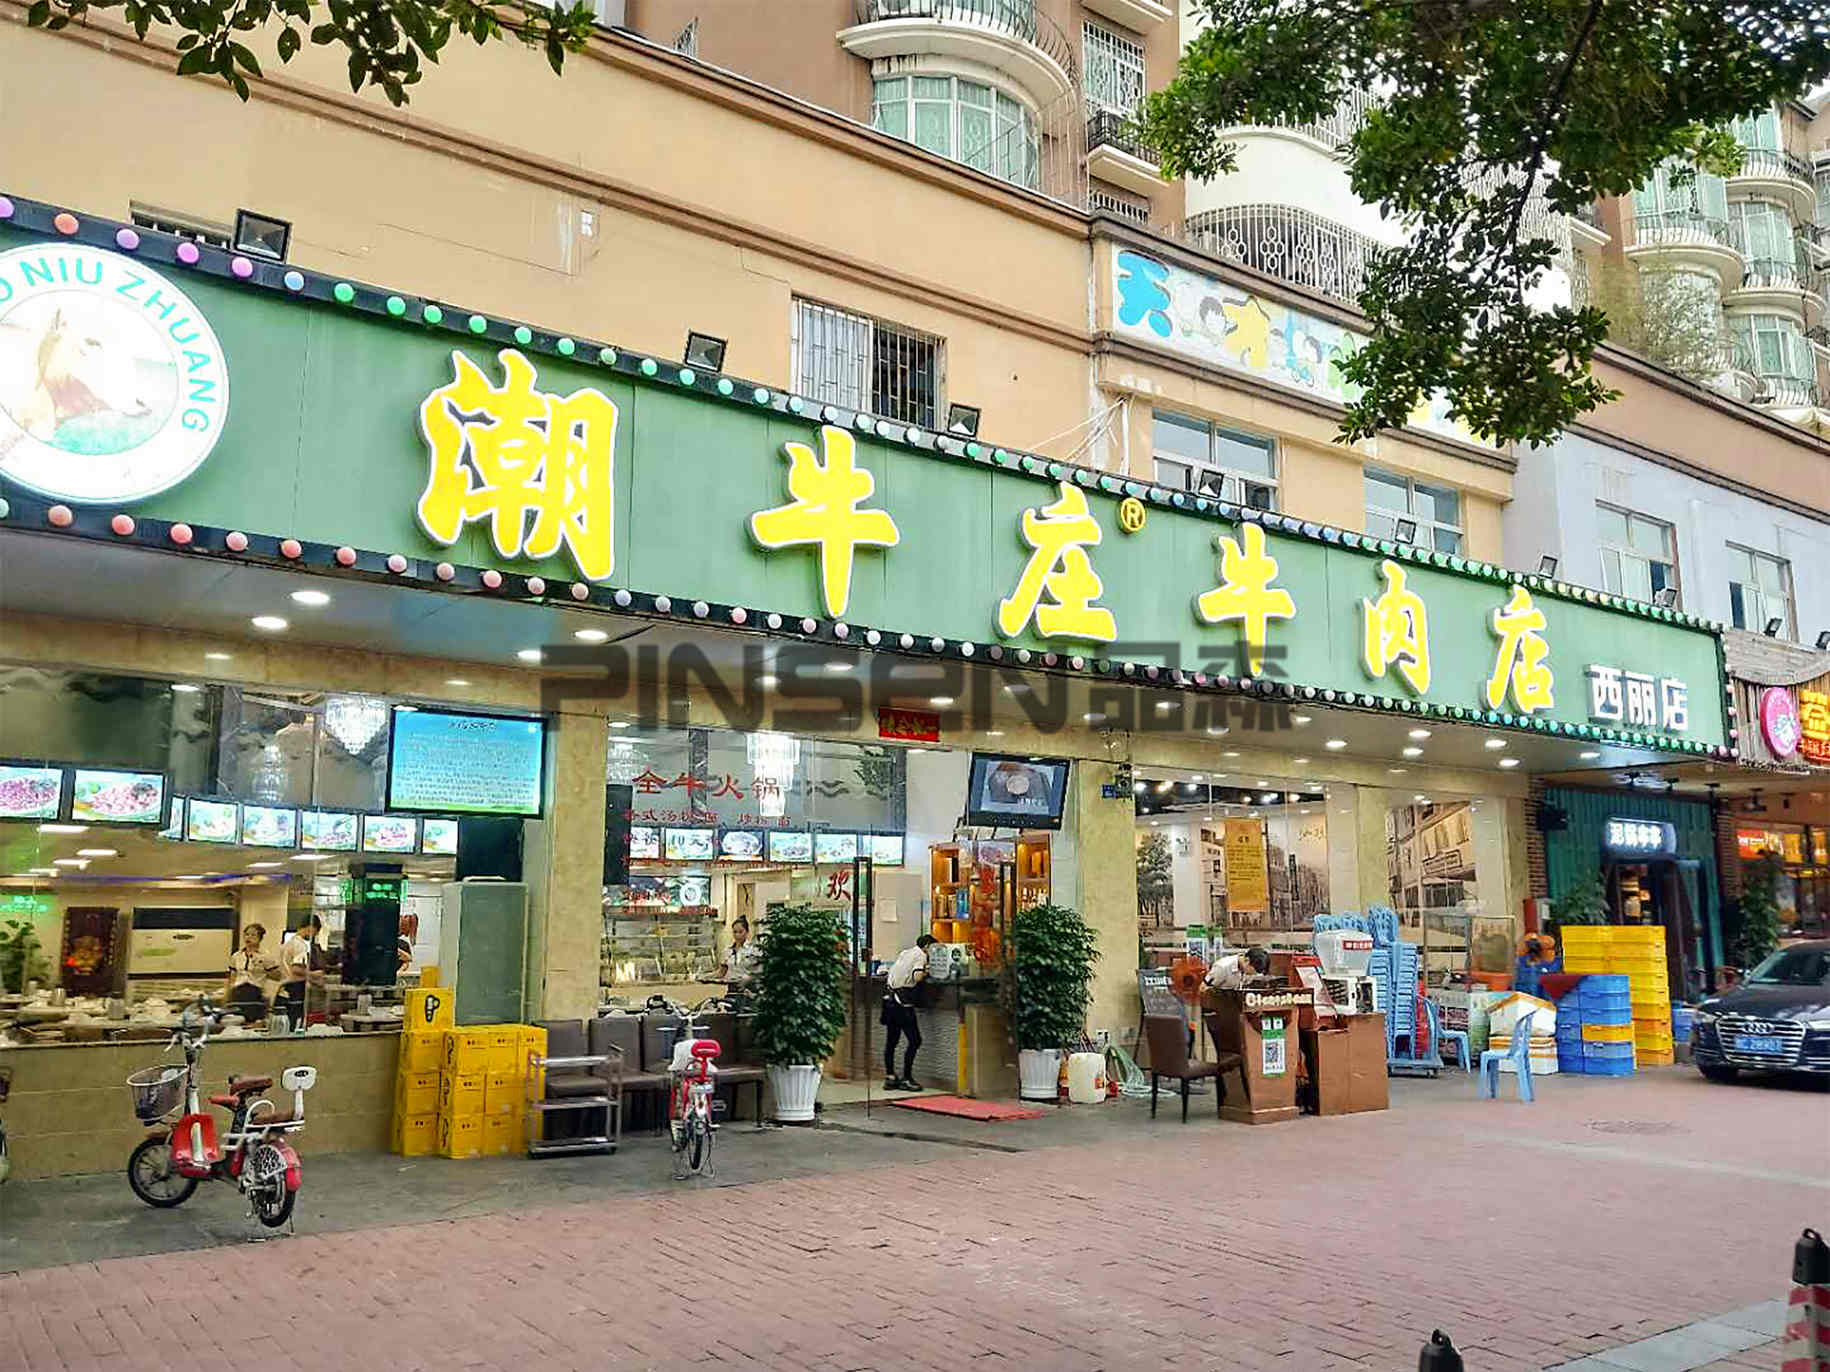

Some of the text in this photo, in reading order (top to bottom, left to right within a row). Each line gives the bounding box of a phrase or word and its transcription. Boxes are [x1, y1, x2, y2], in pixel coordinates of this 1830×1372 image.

[19, 256, 103, 287] NIU
[114, 268, 217, 434] ZHUANG
[1585, 663, 1690, 731] 西丽店
[631, 766, 781, 801] 全牛火锅
